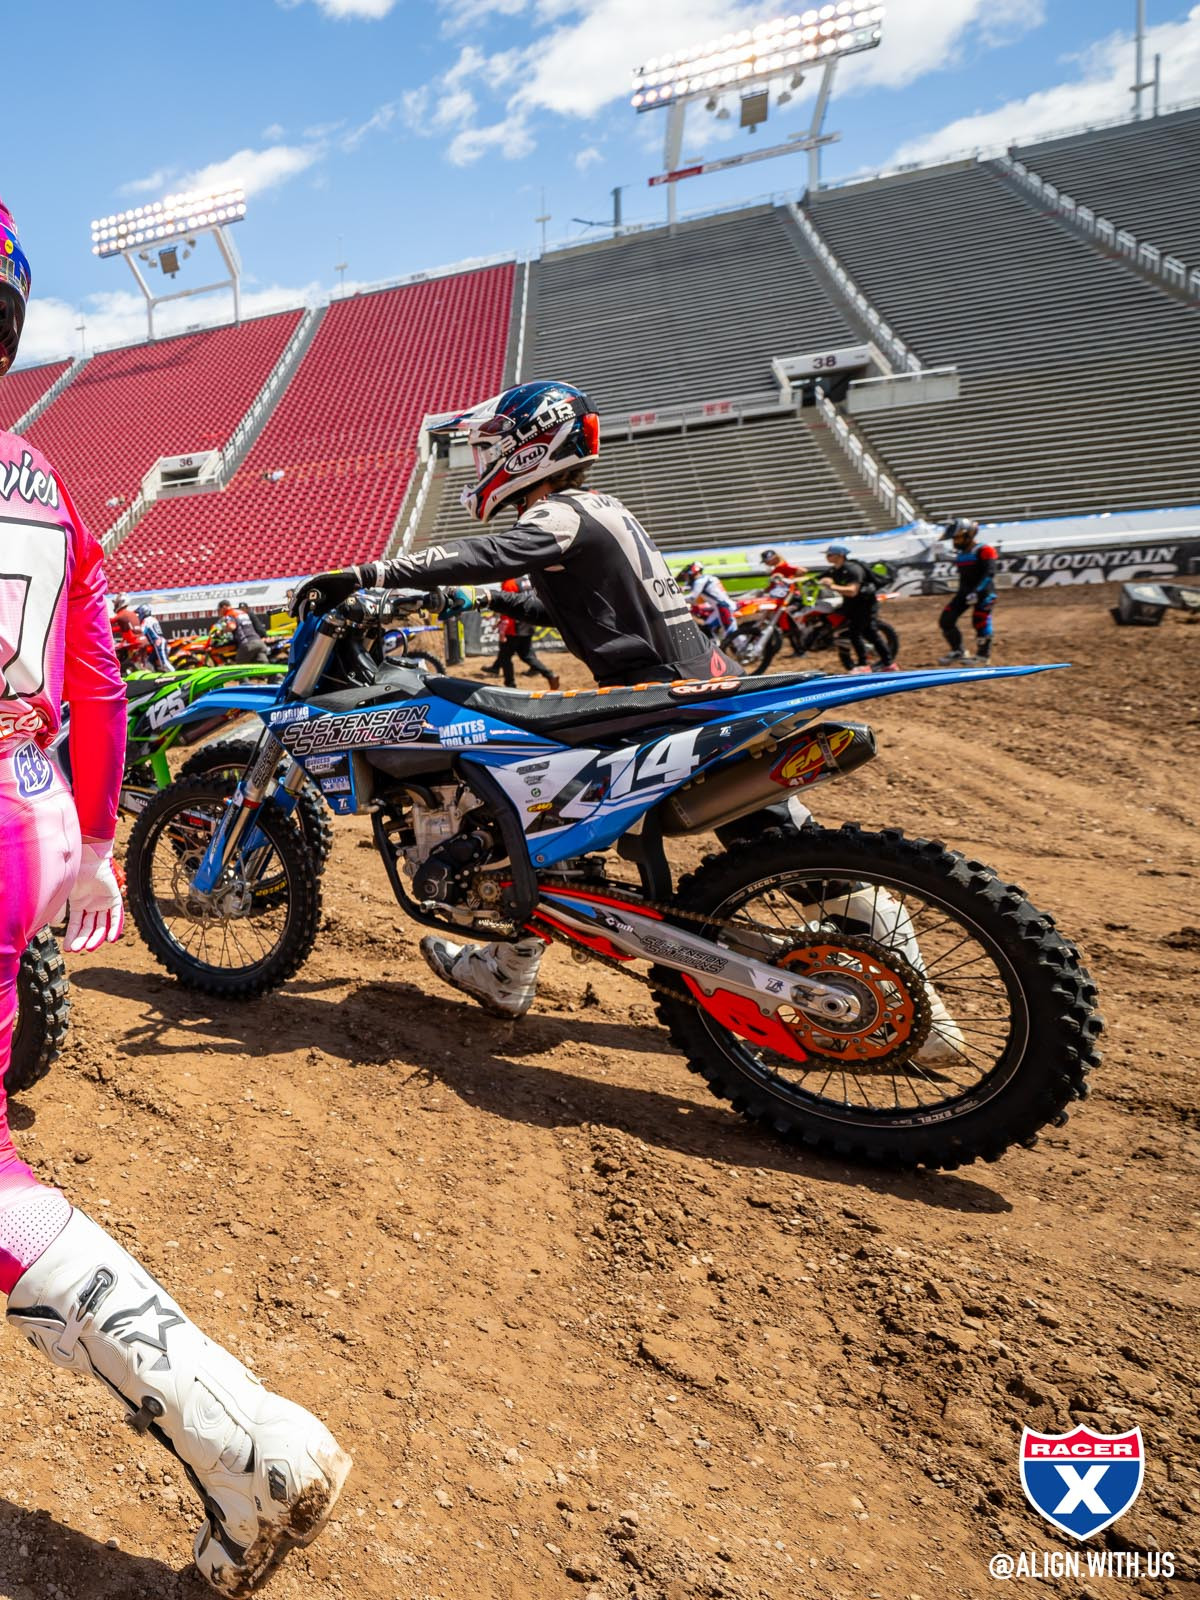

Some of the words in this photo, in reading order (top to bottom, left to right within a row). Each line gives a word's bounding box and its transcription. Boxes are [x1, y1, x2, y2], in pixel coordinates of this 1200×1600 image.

[812, 355, 837, 369] 38
[501, 403, 576, 452] BLUR
[511, 445, 545, 471] Arai
[1020, 546, 1179, 572] MOUNTAIN
[171, 628, 207, 639] UTAH
[671, 680, 742, 695] GUTS
[146, 689, 186, 730] 125
[281, 703, 430, 745] SUSPENSION
[292, 719, 424, 757] SOLUTIONS
[438, 719, 486, 739] MATTES
[440, 736, 464, 749] TOOL
[464, 736, 472, 746] &
[472, 732, 488, 744] DIE
[782, 728, 855, 779] FMF
[641, 934, 728, 966] SUSPENSION
[646, 944, 725, 974] SOLUTIONS
